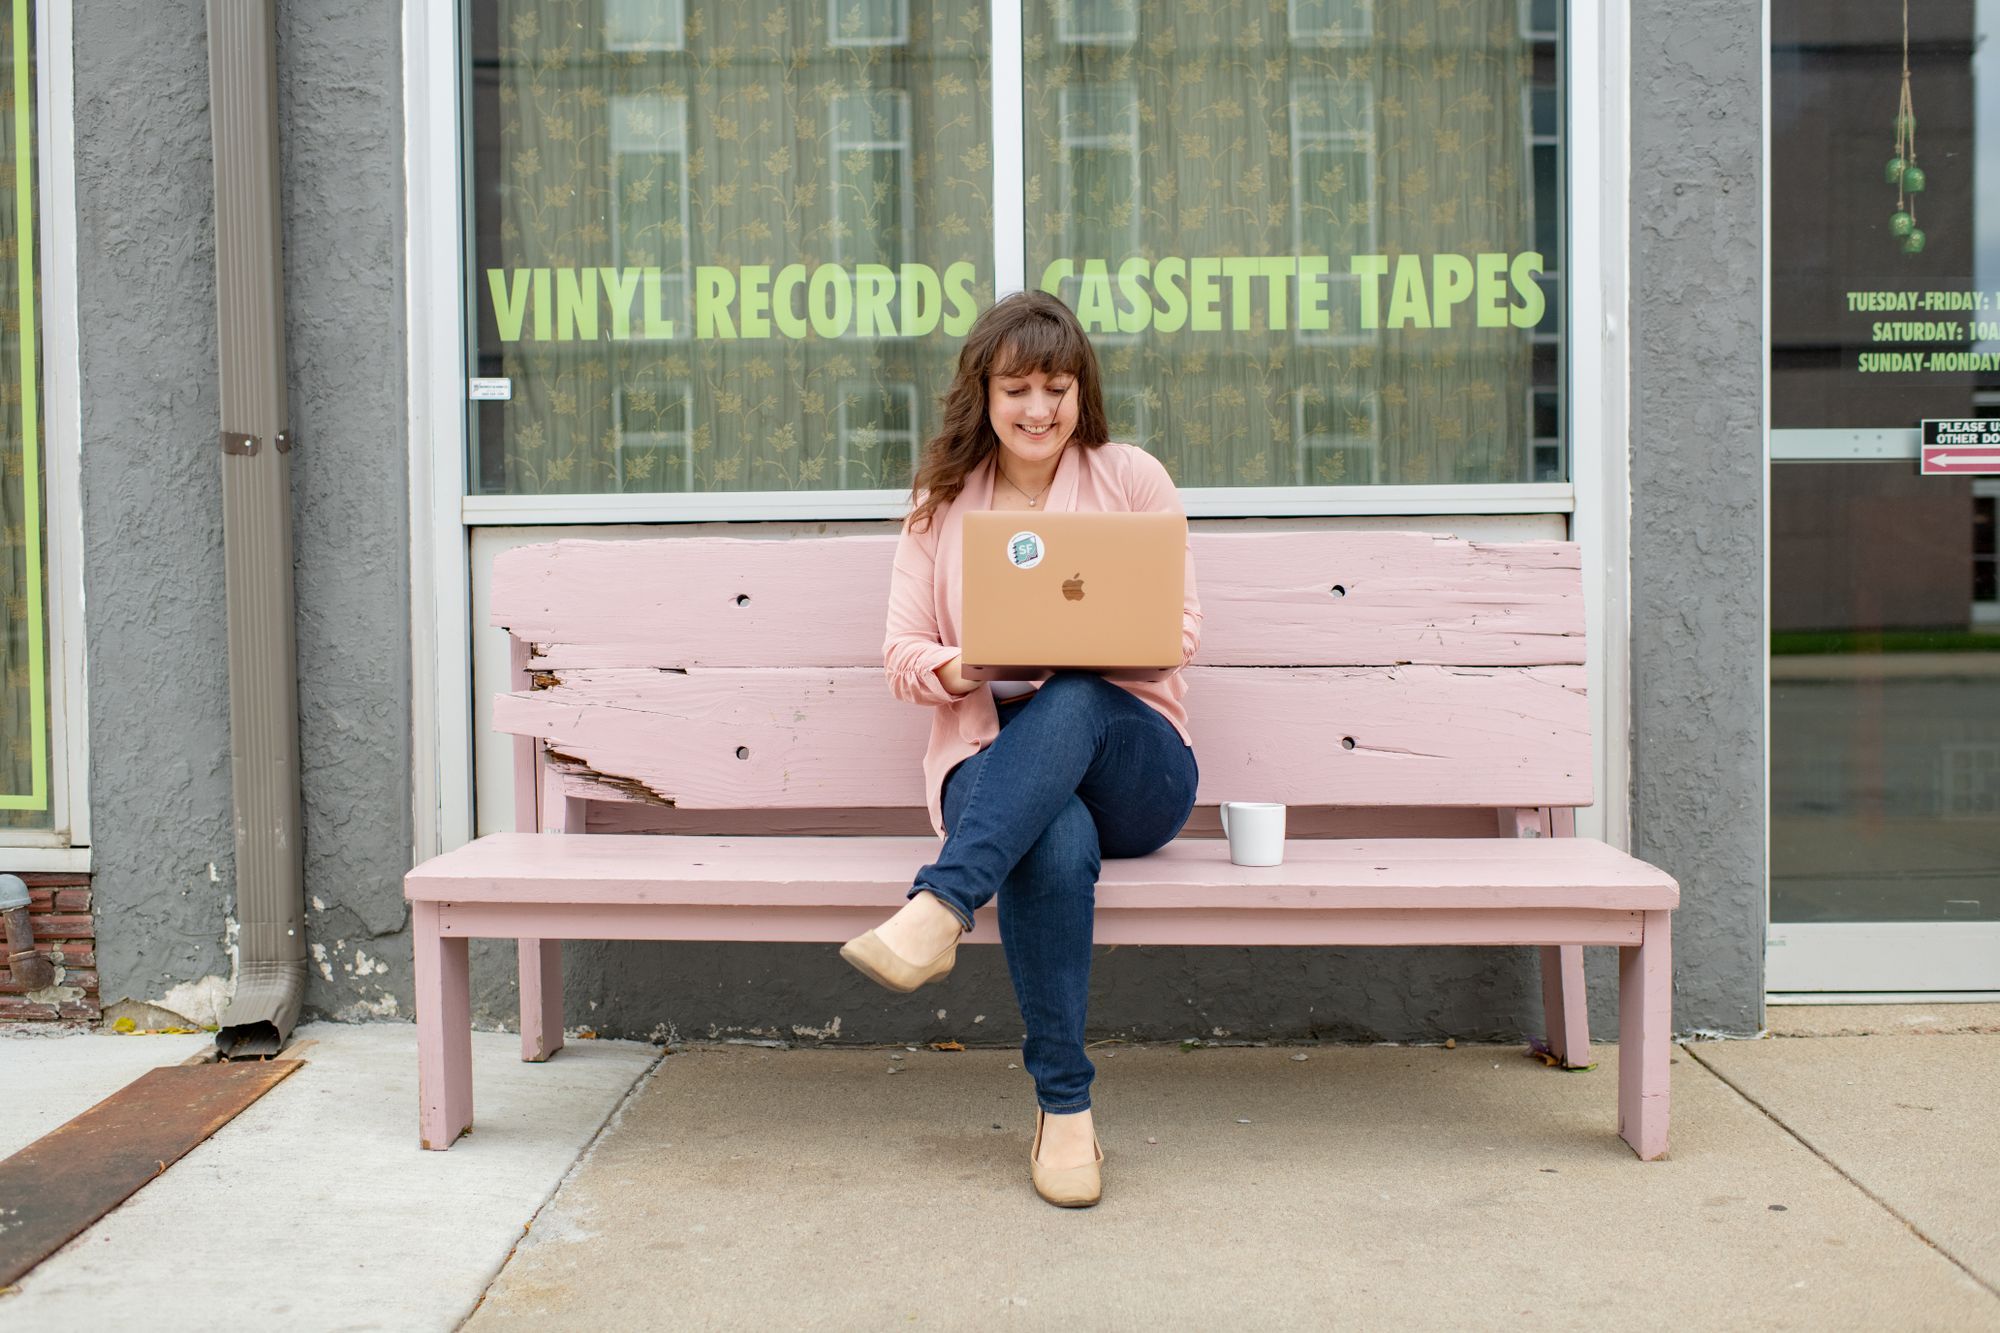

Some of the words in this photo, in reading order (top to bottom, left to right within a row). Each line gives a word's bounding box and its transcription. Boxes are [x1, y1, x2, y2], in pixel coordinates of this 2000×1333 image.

[1351, 251, 1546, 329] TAPES
[487, 267, 673, 342] VINYL
[696, 261, 978, 339] RECORDS
[1847, 291, 1990, 311] TUESDAY-FRIDAY:
[1872, 321, 1963, 342] SATURDAY:
[1858, 352, 2000, 373] SUNDAY-MONDAY
[1938, 422, 1987, 432] PLEASE
[1936, 433, 1979, 444] OTHER
[1018, 543, 1033, 555] SF
